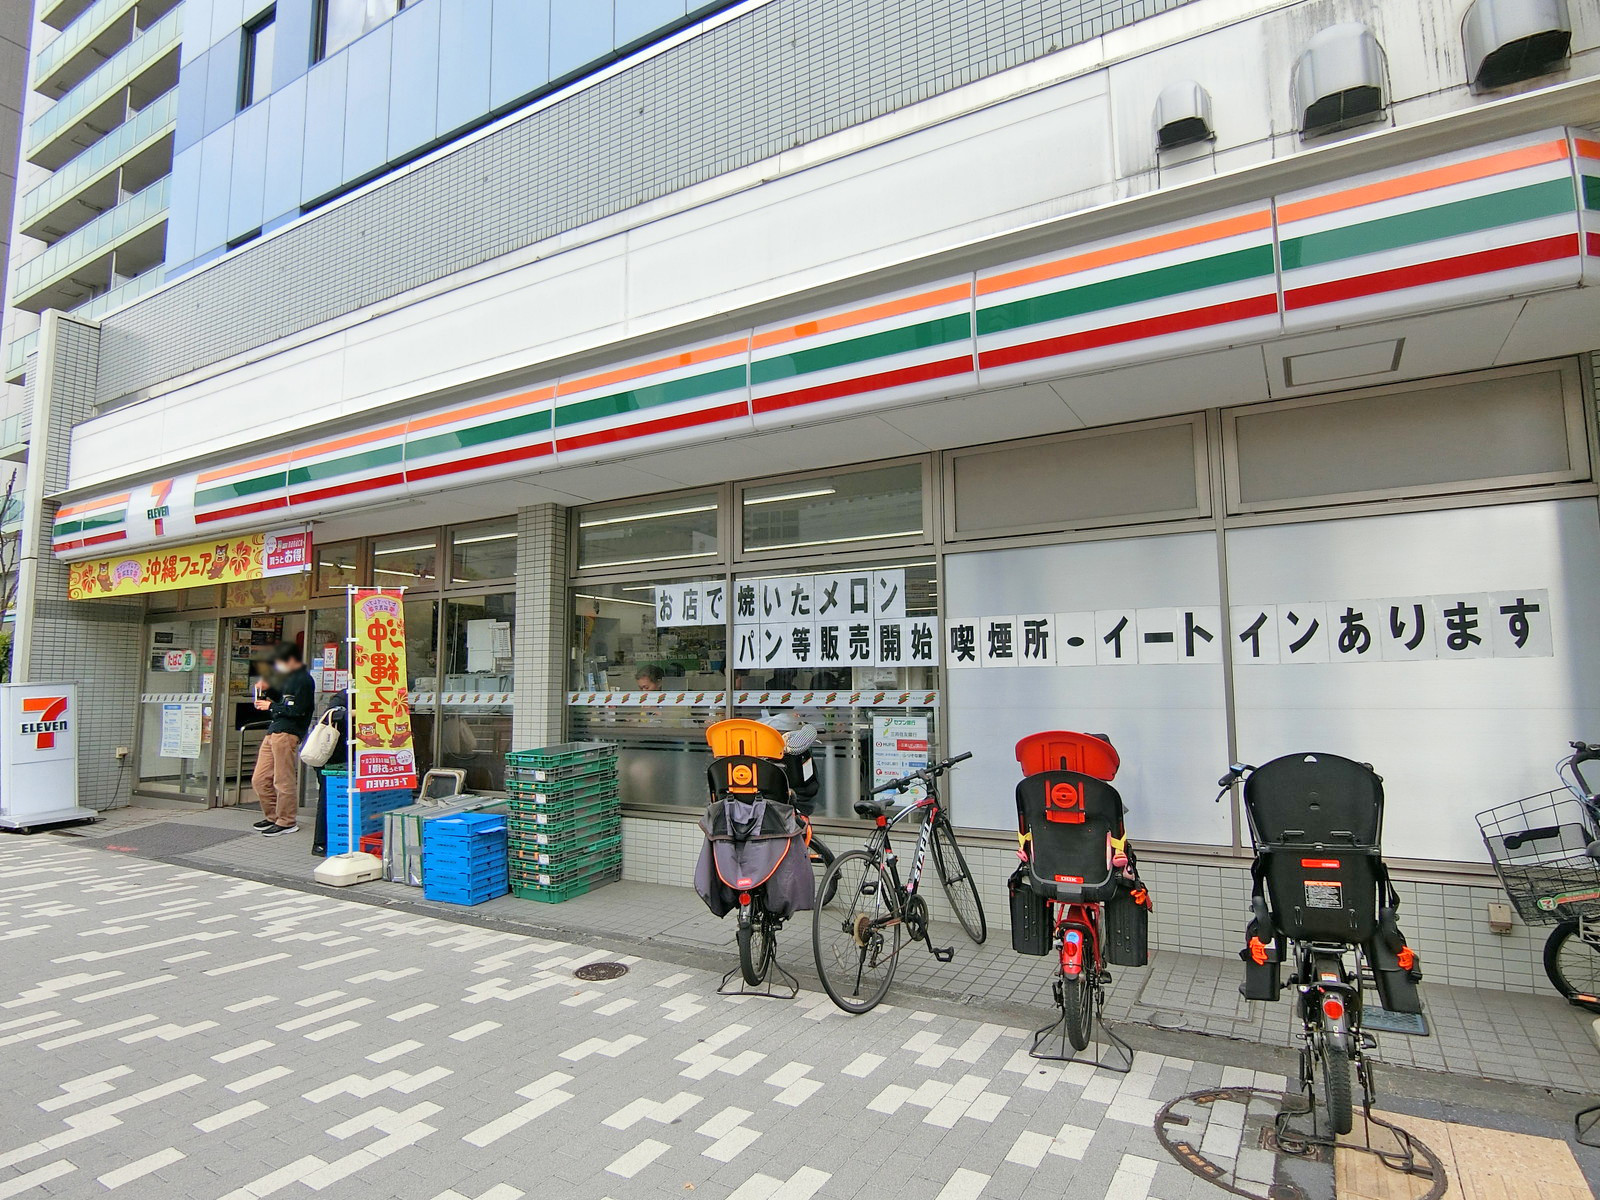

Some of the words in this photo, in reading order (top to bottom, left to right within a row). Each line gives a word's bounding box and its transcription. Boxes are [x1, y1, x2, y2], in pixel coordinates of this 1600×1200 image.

[141, 553, 212, 585] 沖縄フェア
[739, 623, 933, 663] パン等販売開始
